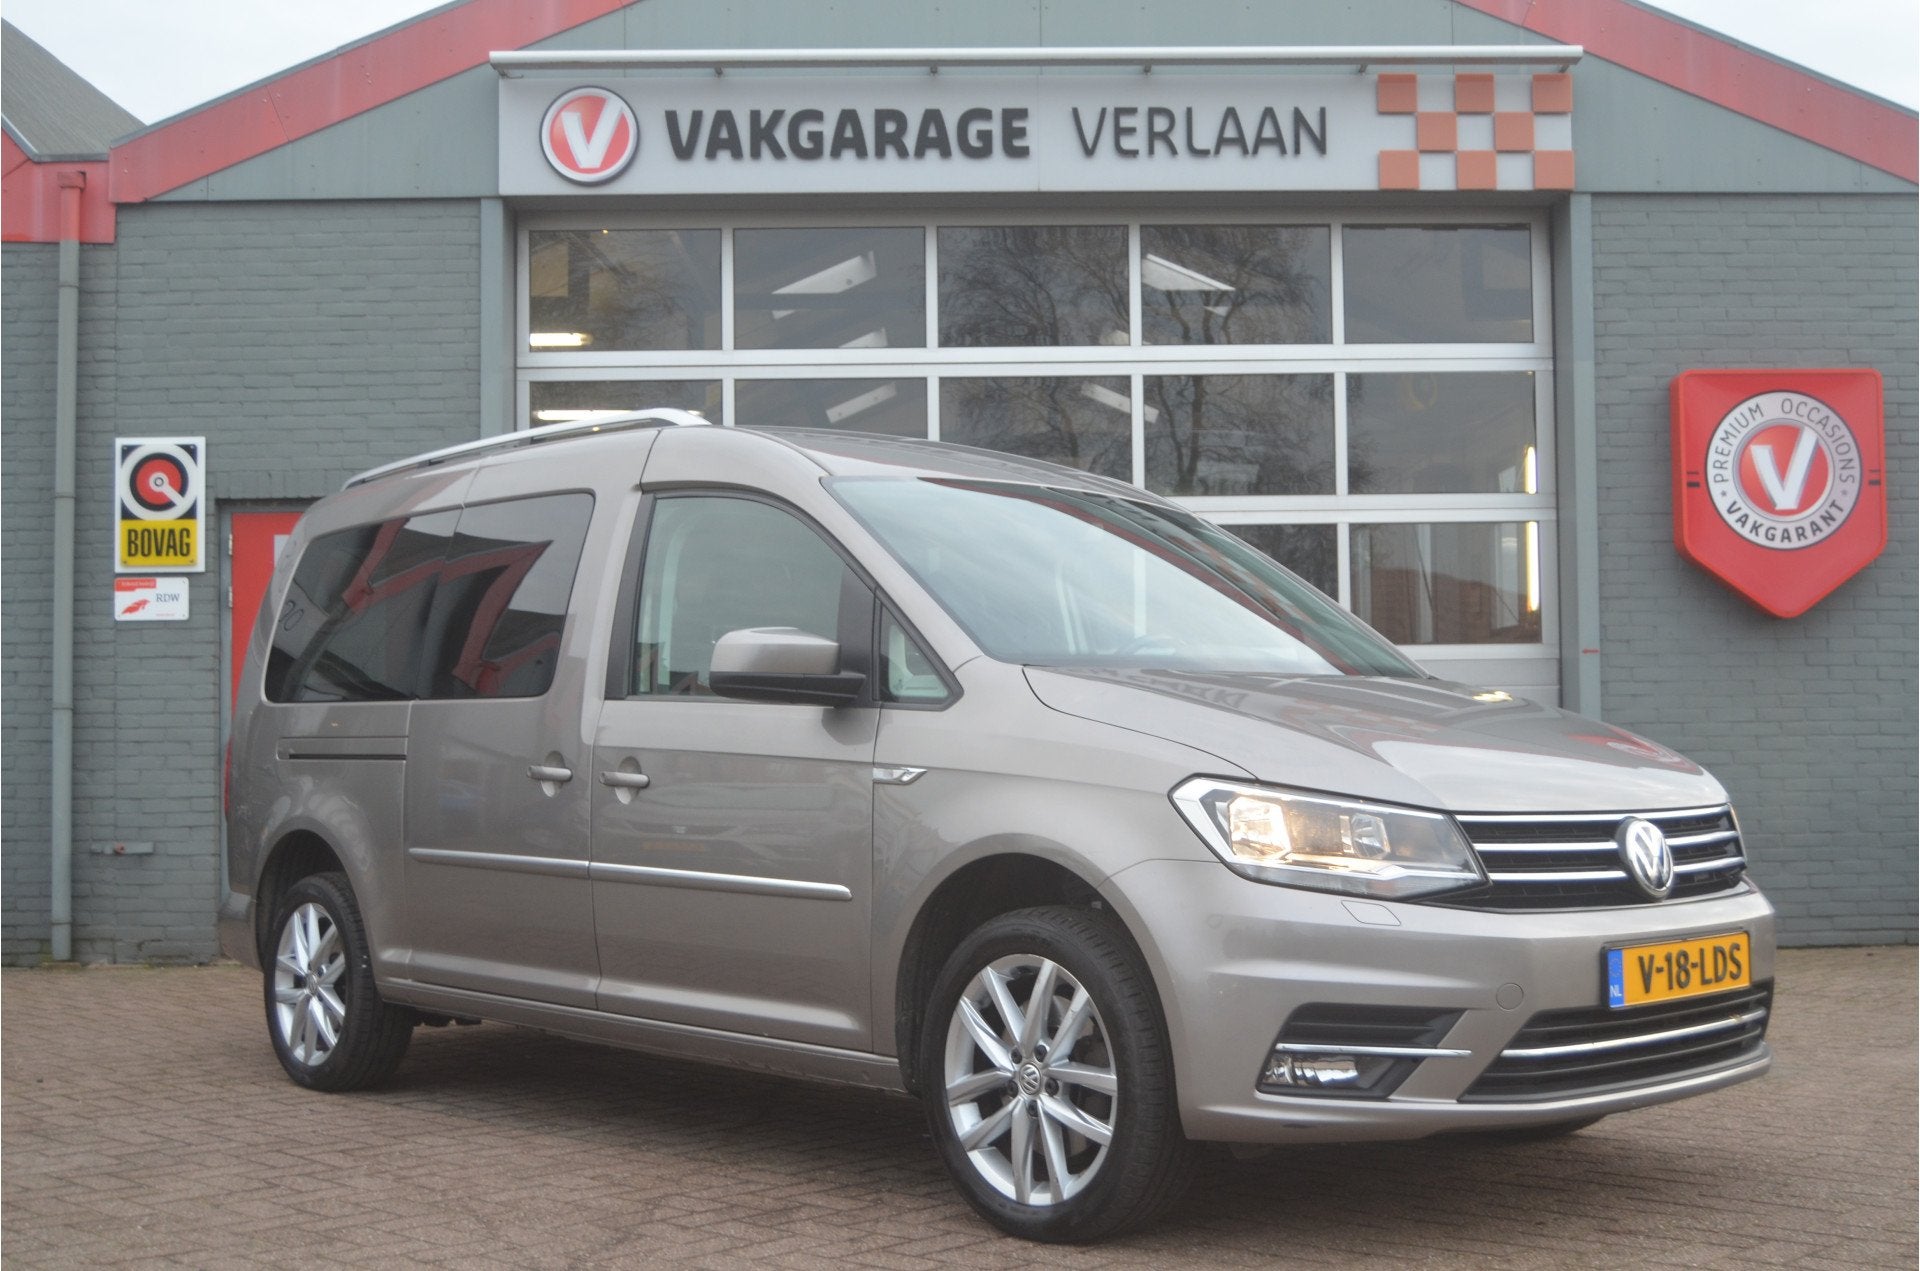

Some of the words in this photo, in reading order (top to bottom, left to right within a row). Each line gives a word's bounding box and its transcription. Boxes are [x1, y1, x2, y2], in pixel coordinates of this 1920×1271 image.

[665, 107, 1030, 160] VAKGARAGE
[1071, 106, 1327, 158] VERLAAN
[1713, 402, 1765, 484] PREMIUM
[1780, 397, 1855, 484] OCCASIONS
[127, 528, 191, 558] BOVAG
[1726, 499, 1845, 543] VAKGARANT
[156, 593, 181, 602] RDW
[1609, 985, 1622, 997] NL
[1638, 942, 1742, 994] V-18-LDS
